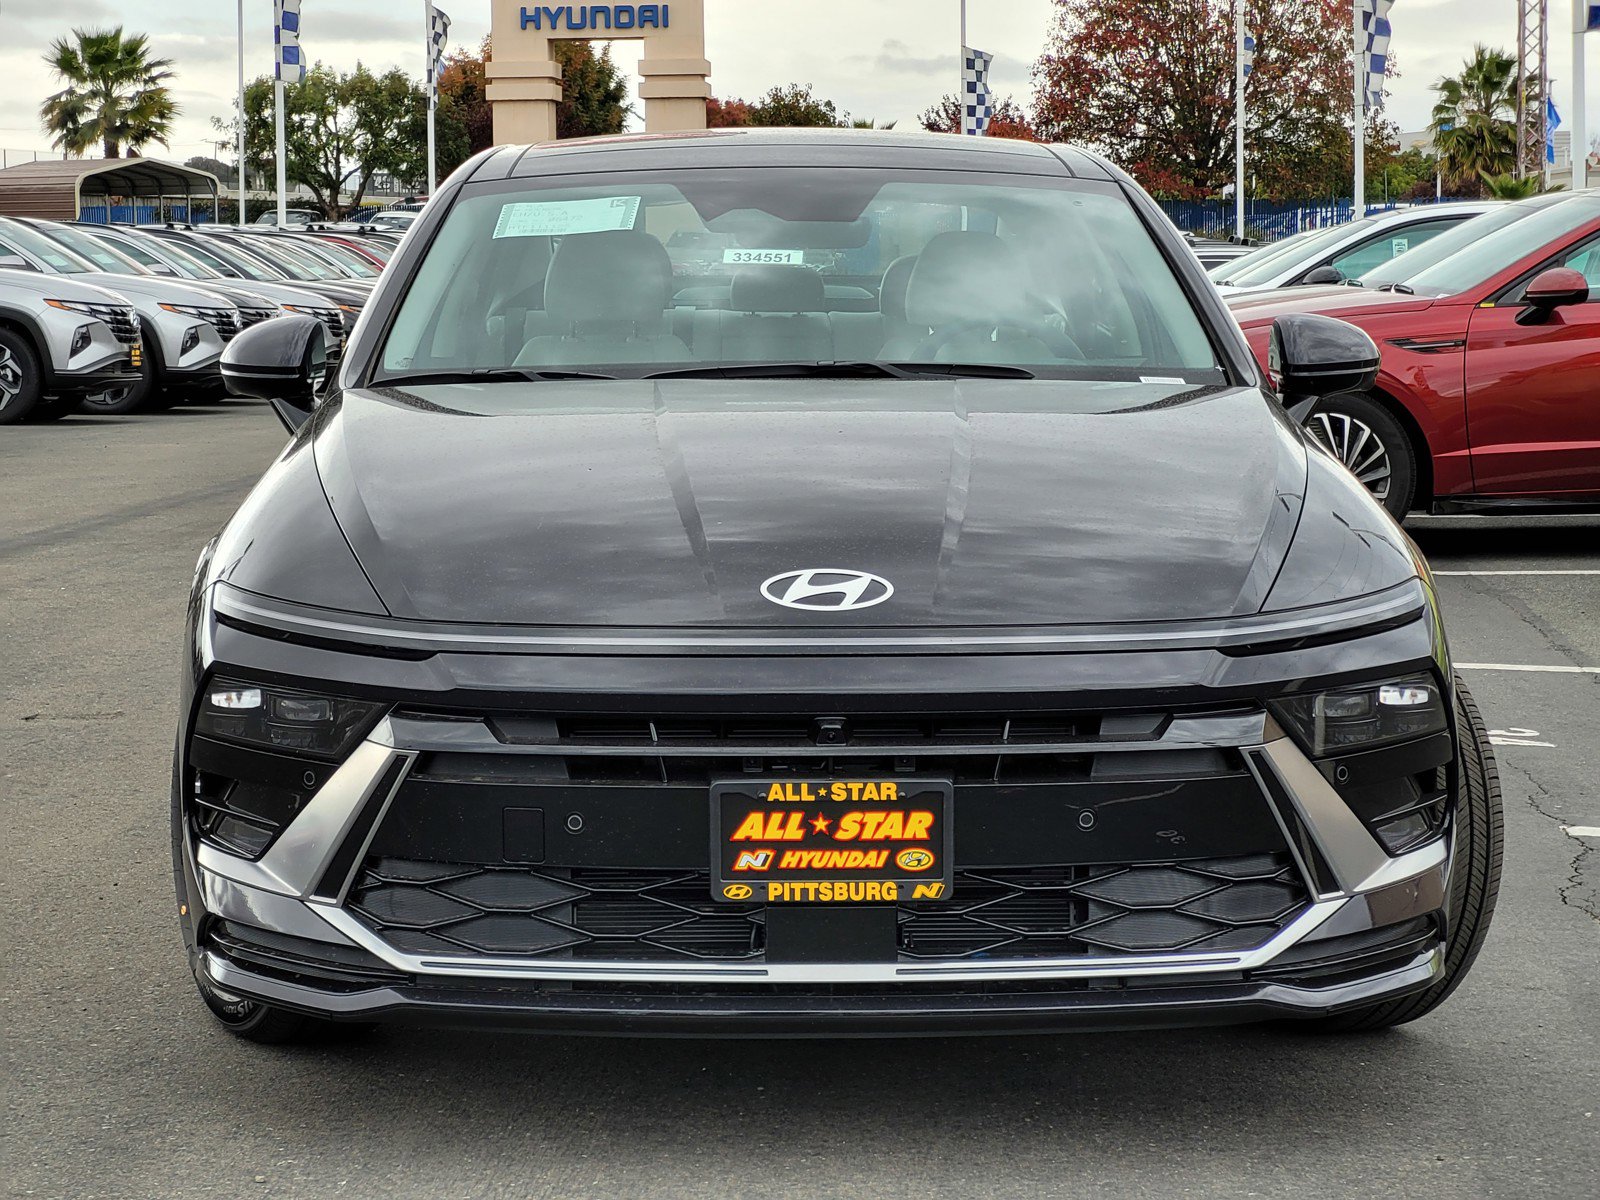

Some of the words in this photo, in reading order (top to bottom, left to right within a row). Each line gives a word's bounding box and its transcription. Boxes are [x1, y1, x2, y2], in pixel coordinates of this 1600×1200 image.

[520, 4, 669, 30] HYUNDAI
[732, 252, 791, 263] 334551
[767, 783, 815, 801] ALL
[831, 782, 897, 801] STAR
[730, 811, 806, 841] ALL
[832, 811, 934, 841] STAR
[778, 850, 890, 869] HYUNDAI
[768, 882, 898, 901] PITTSBURG
